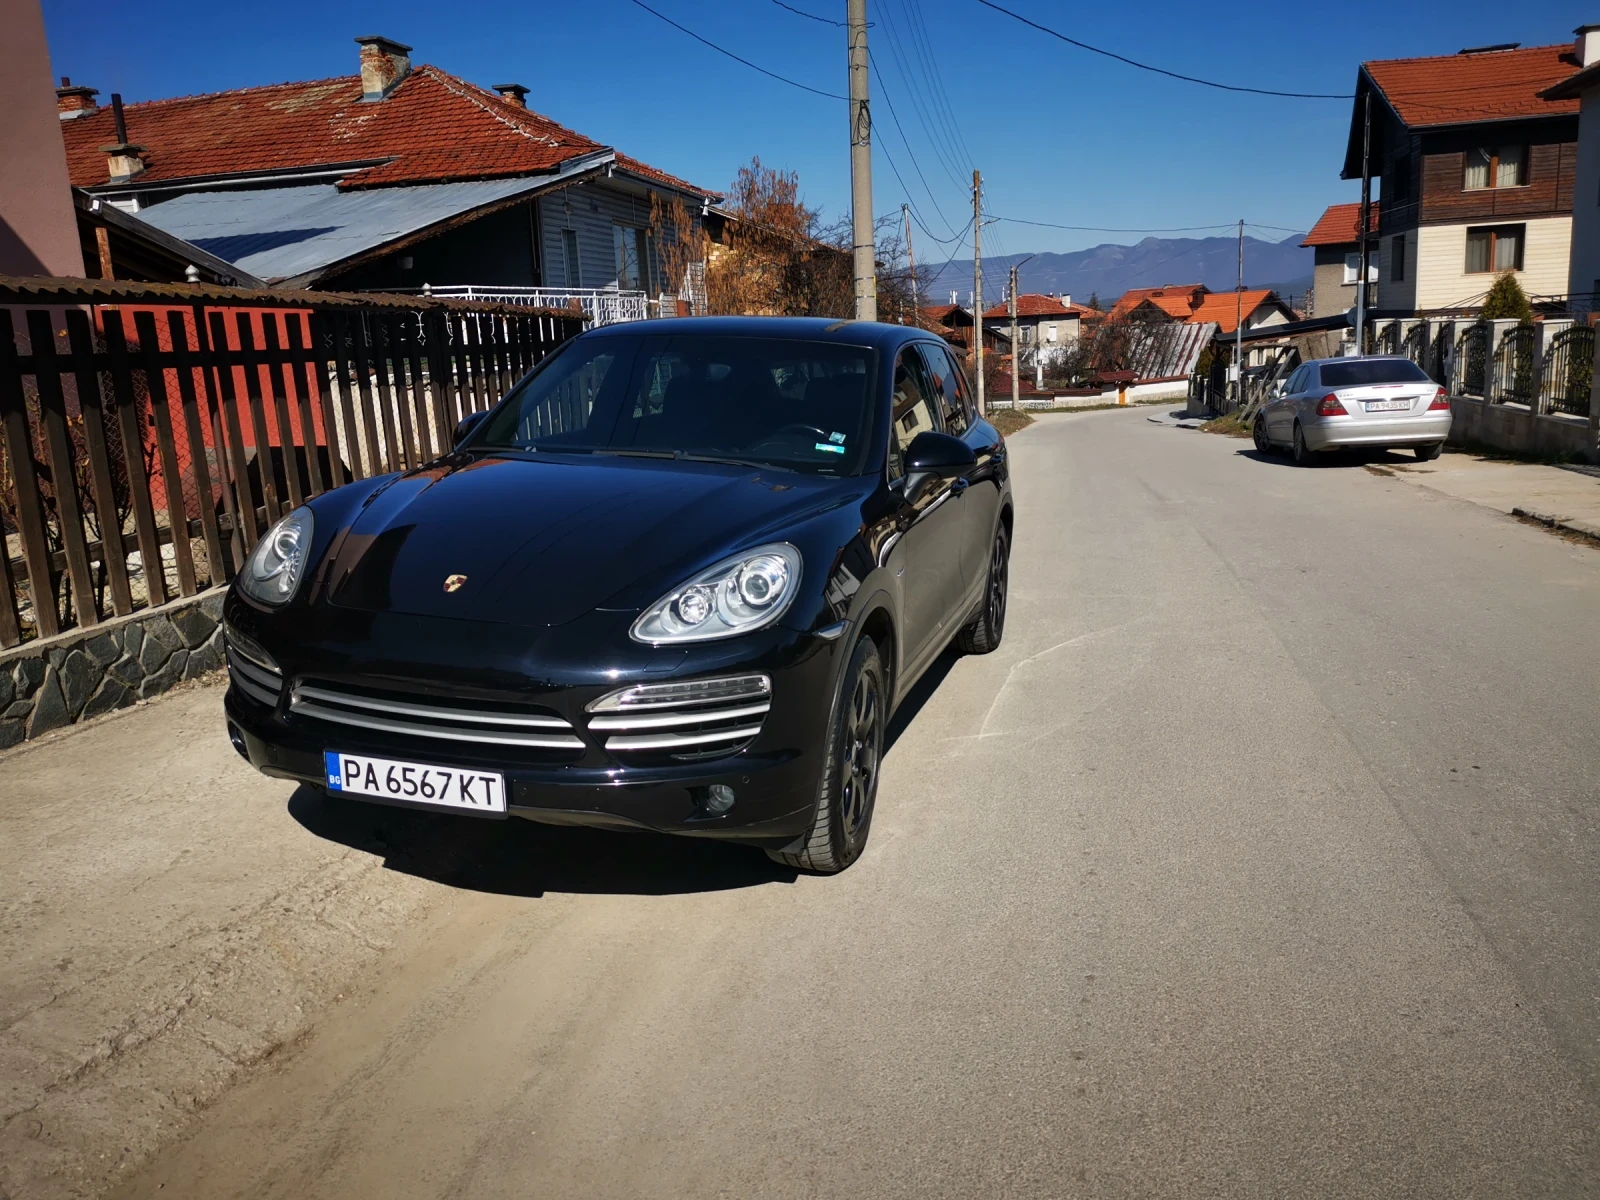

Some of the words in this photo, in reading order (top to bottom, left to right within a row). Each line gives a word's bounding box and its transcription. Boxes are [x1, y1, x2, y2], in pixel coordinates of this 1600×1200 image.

[329, 774, 341, 785] BG
[343, 758, 380, 791] PA
[386, 765, 453, 800] 6567
[459, 773, 496, 806] KT
